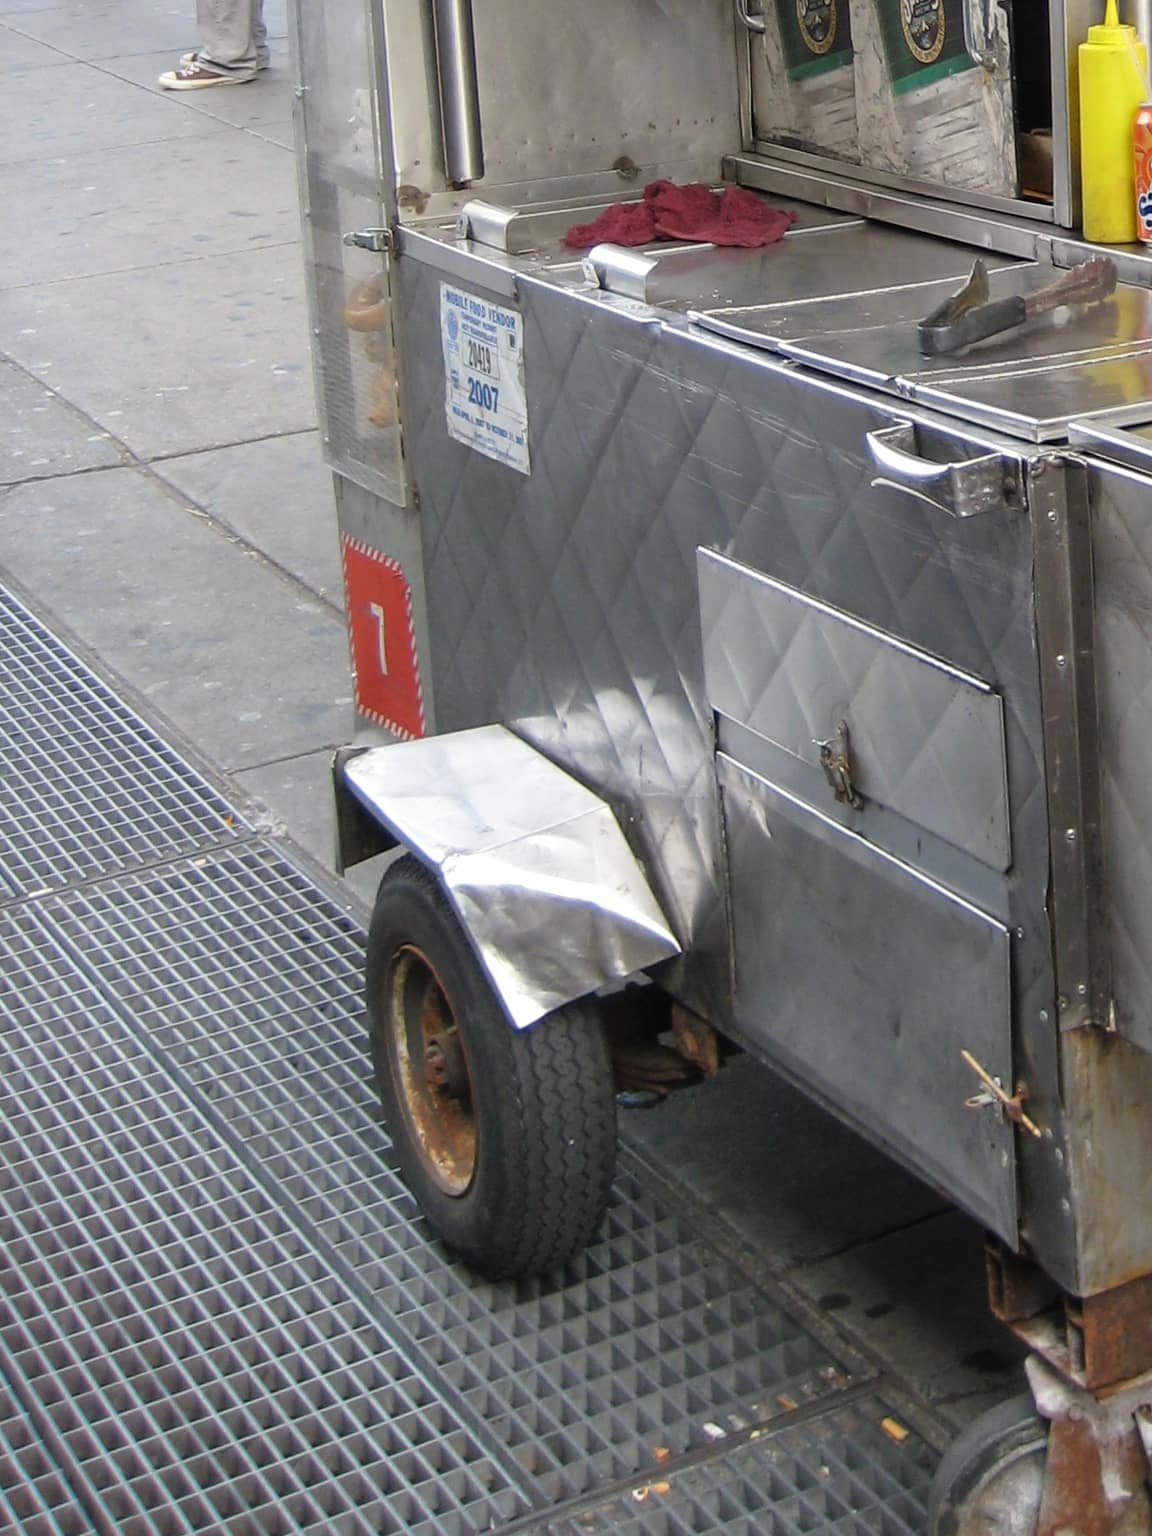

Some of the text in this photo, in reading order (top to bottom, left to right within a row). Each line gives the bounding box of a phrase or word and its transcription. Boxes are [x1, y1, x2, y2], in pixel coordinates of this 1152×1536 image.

[446, 288, 517, 330] MOBILE FOOD VENDOR
[468, 377, 499, 414] 2007
[369, 602, 389, 677] 1
